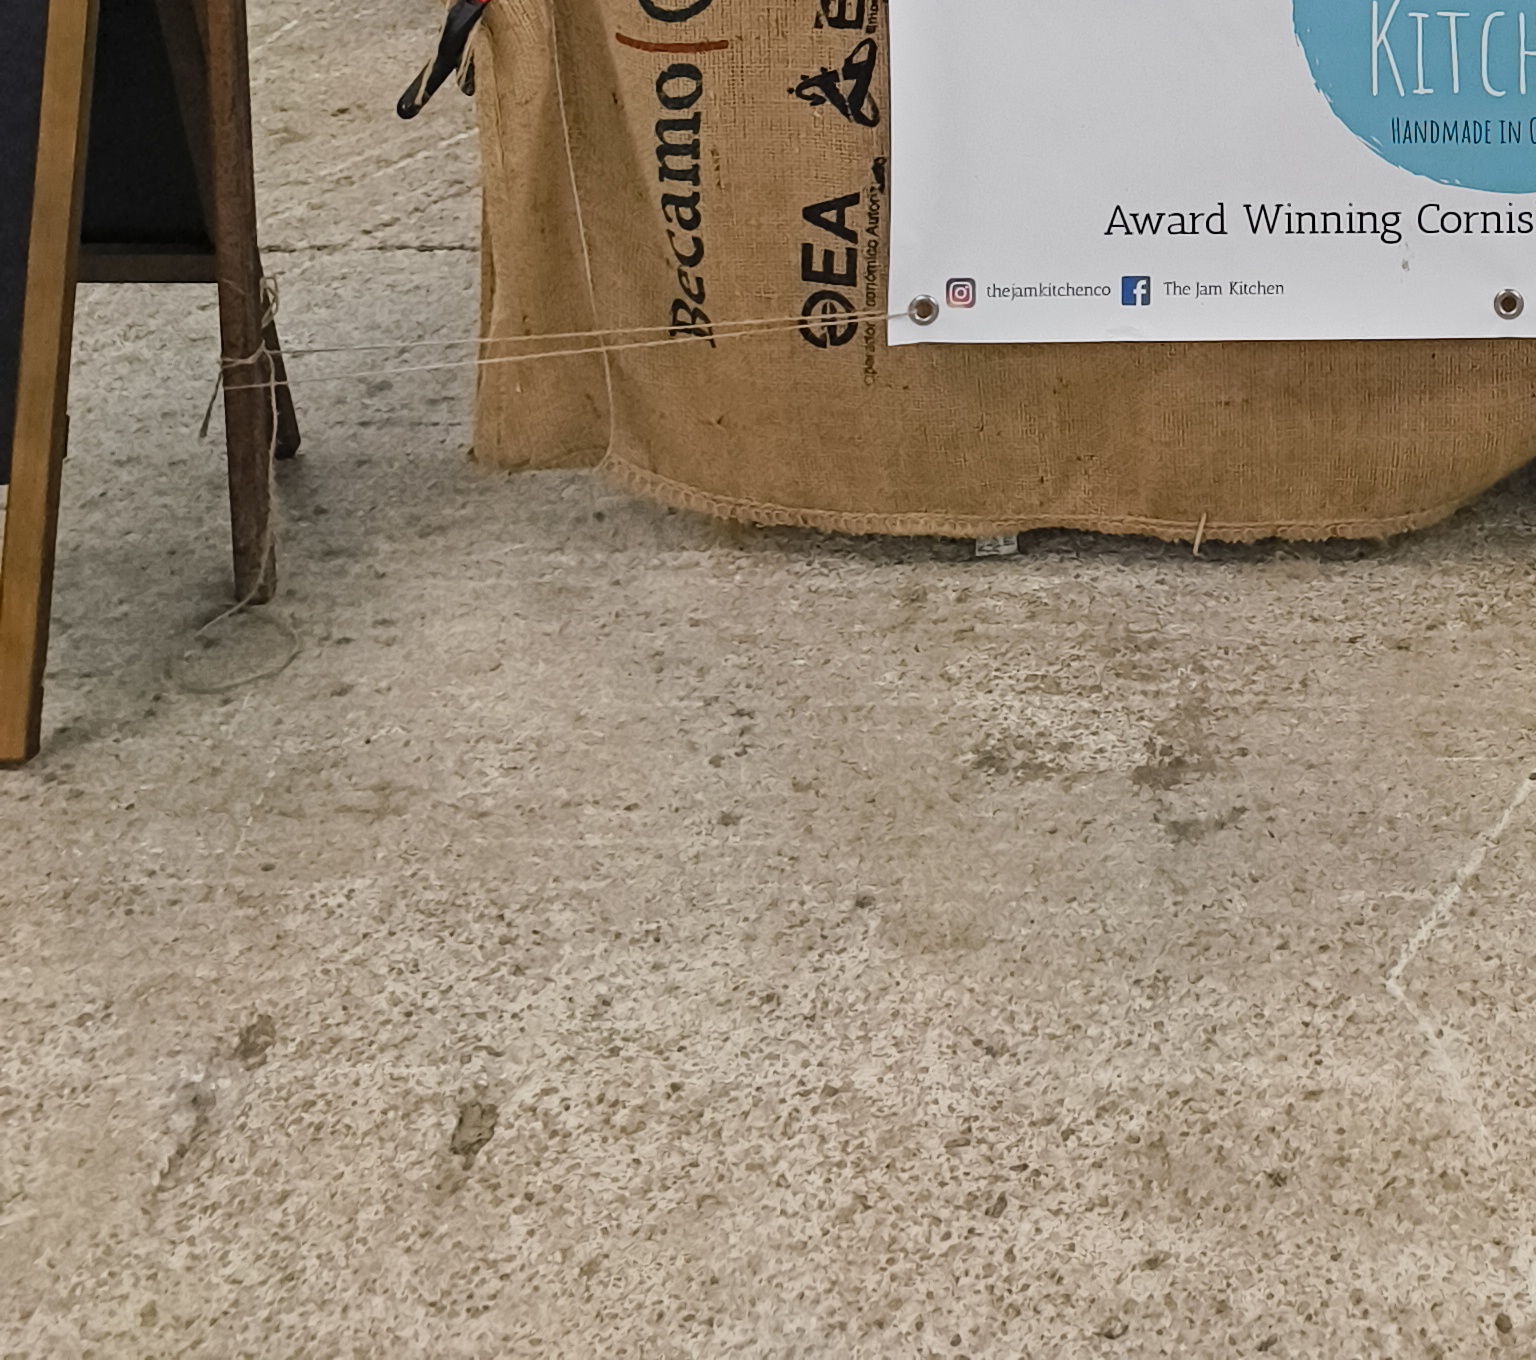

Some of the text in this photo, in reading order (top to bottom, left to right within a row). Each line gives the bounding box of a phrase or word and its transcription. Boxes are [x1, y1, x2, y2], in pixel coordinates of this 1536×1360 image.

[1391, 117, 1492, 145] HANDMADE
[1500, 119, 1521, 145] IN
[655, 63, 716, 348] Becamo
[1104, 202, 1228, 236] Award
[1243, 202, 1403, 244] Winning
[987, 280, 1285, 301] thejamkitchenco The Jam Kitchen
